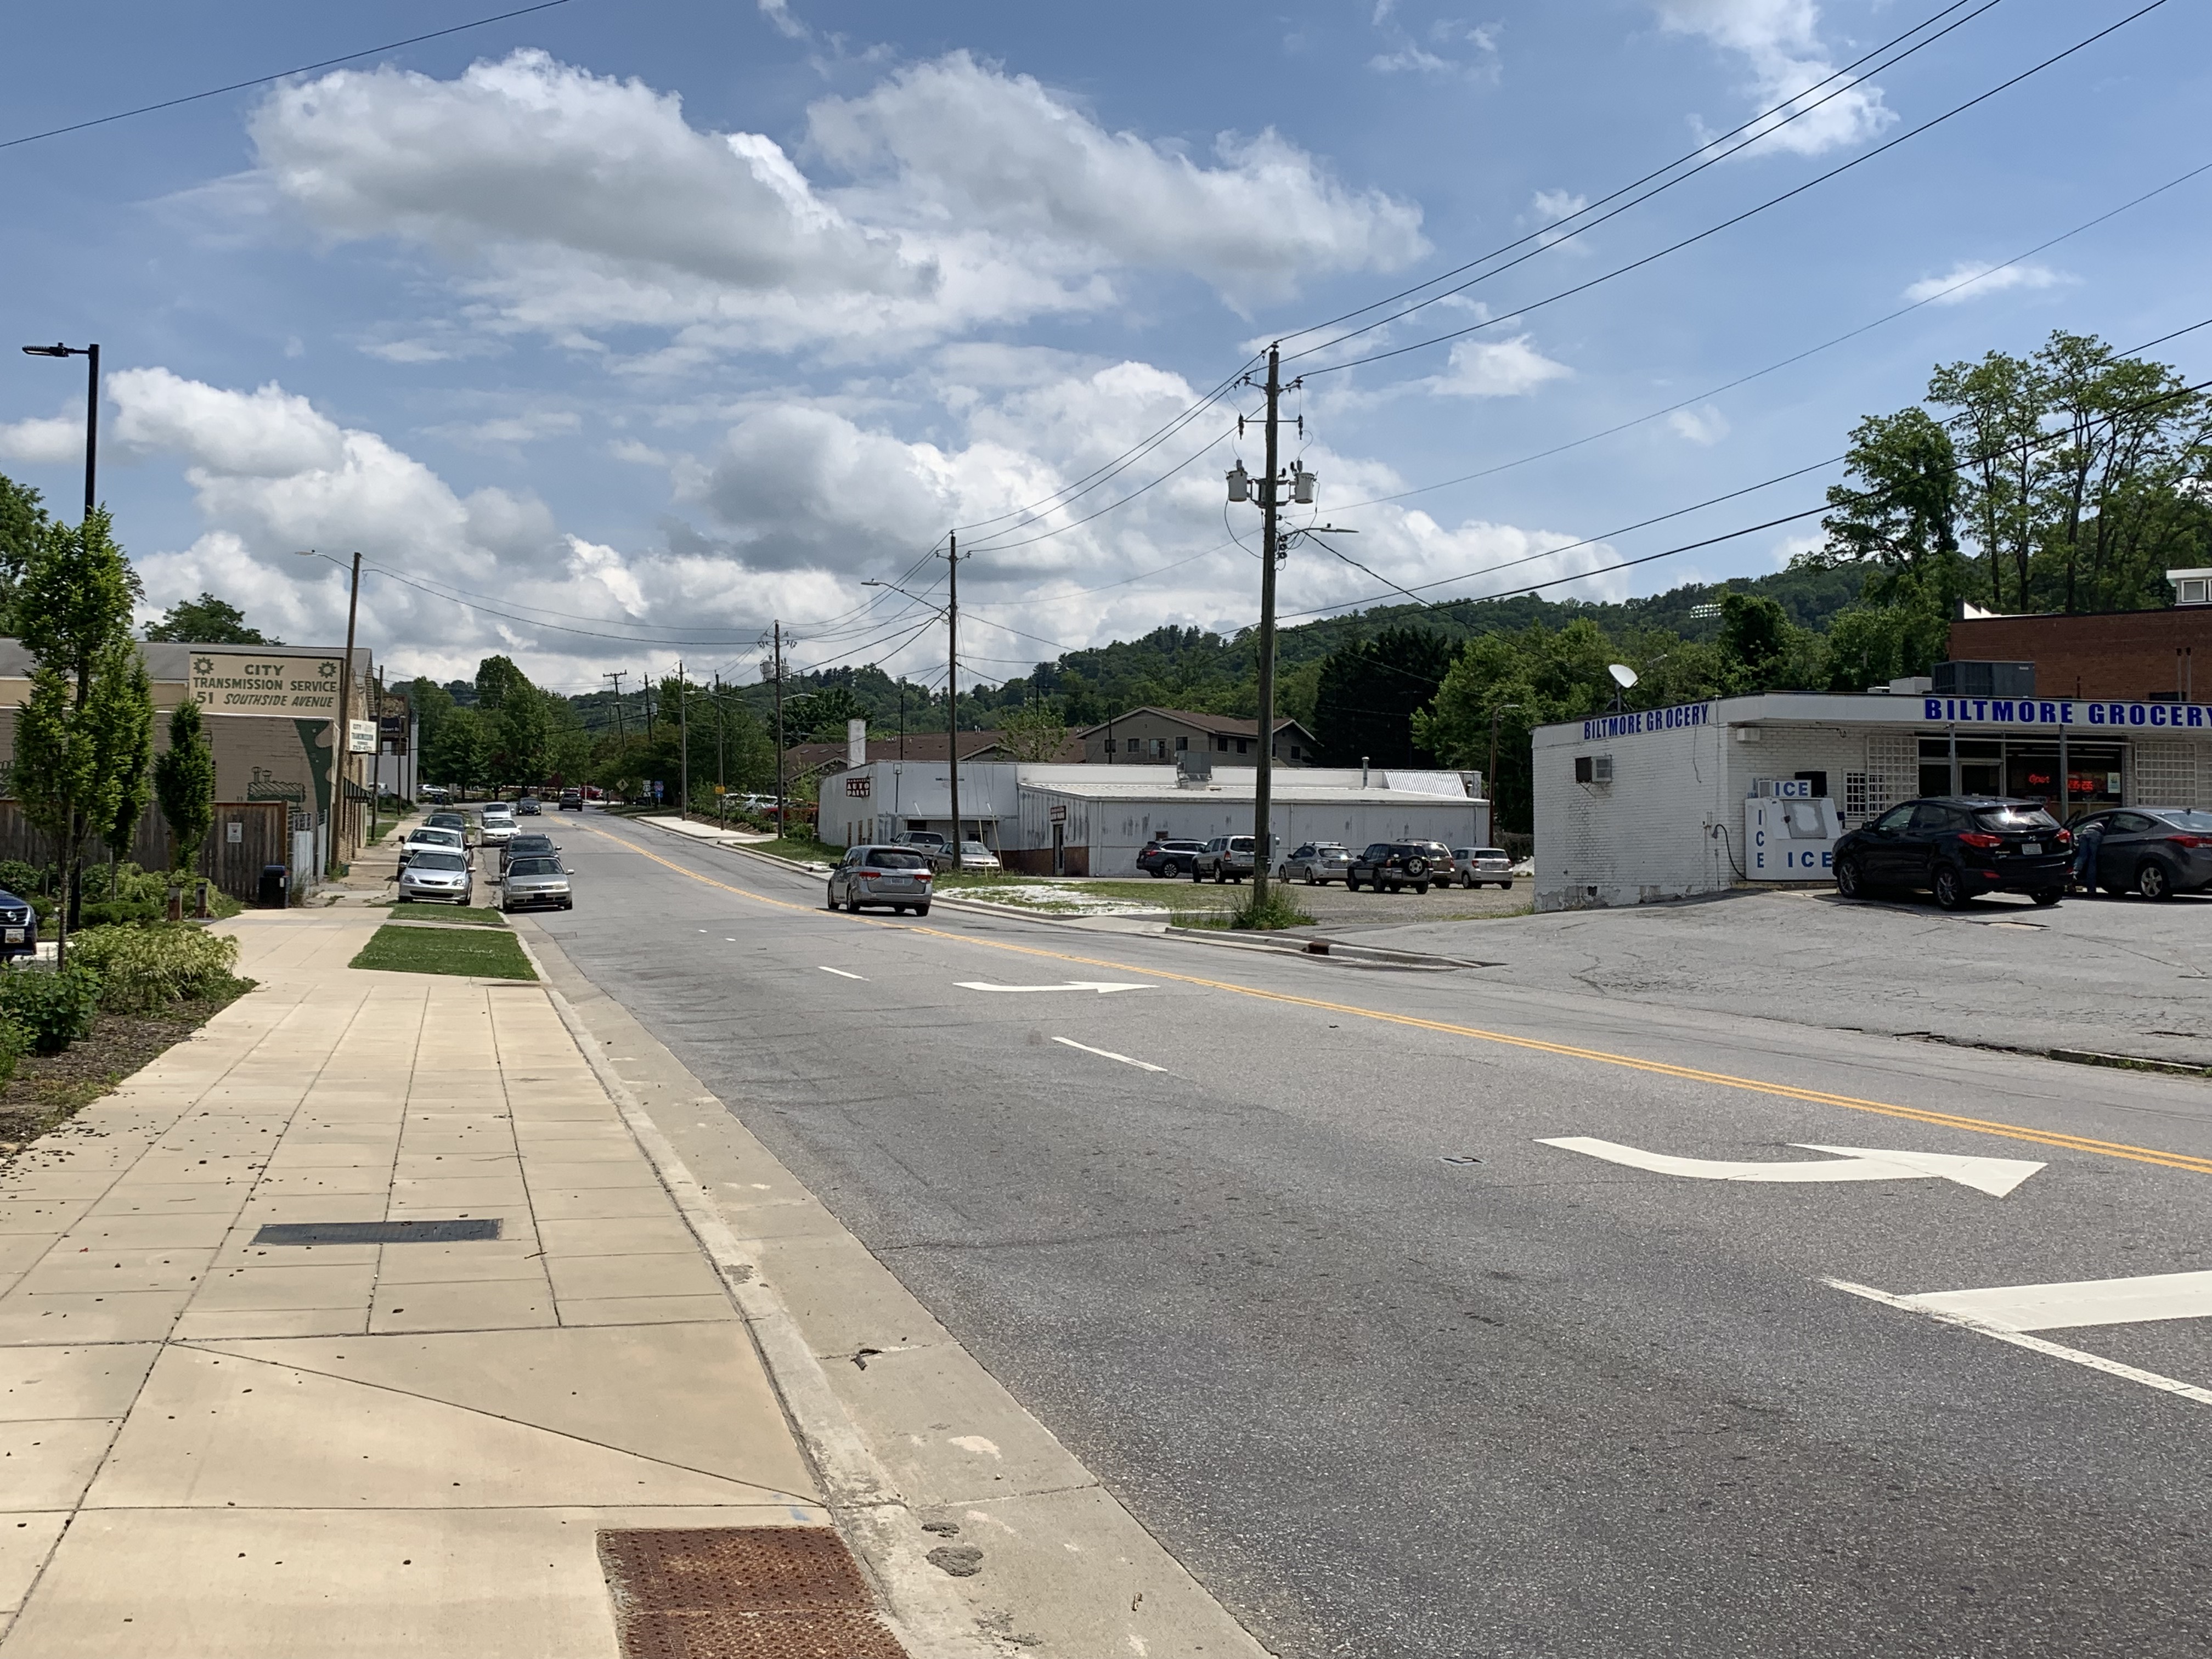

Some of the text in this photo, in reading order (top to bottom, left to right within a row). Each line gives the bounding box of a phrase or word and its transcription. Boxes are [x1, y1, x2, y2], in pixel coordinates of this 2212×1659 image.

[244, 664, 285, 676] CITY
[193, 677, 337, 692] TRANSMISSION SERVICE
[196, 691, 334, 708] 51 SOUTHSIDE AVENUE
[1925, 698, 2073, 724] BILTMORE
[1584, 704, 1708, 740] BILTMORE GROCERY
[1775, 782, 1808, 796] ICE
[1756, 809, 1764, 868] ICE
[1787, 851, 1832, 868] ICE
